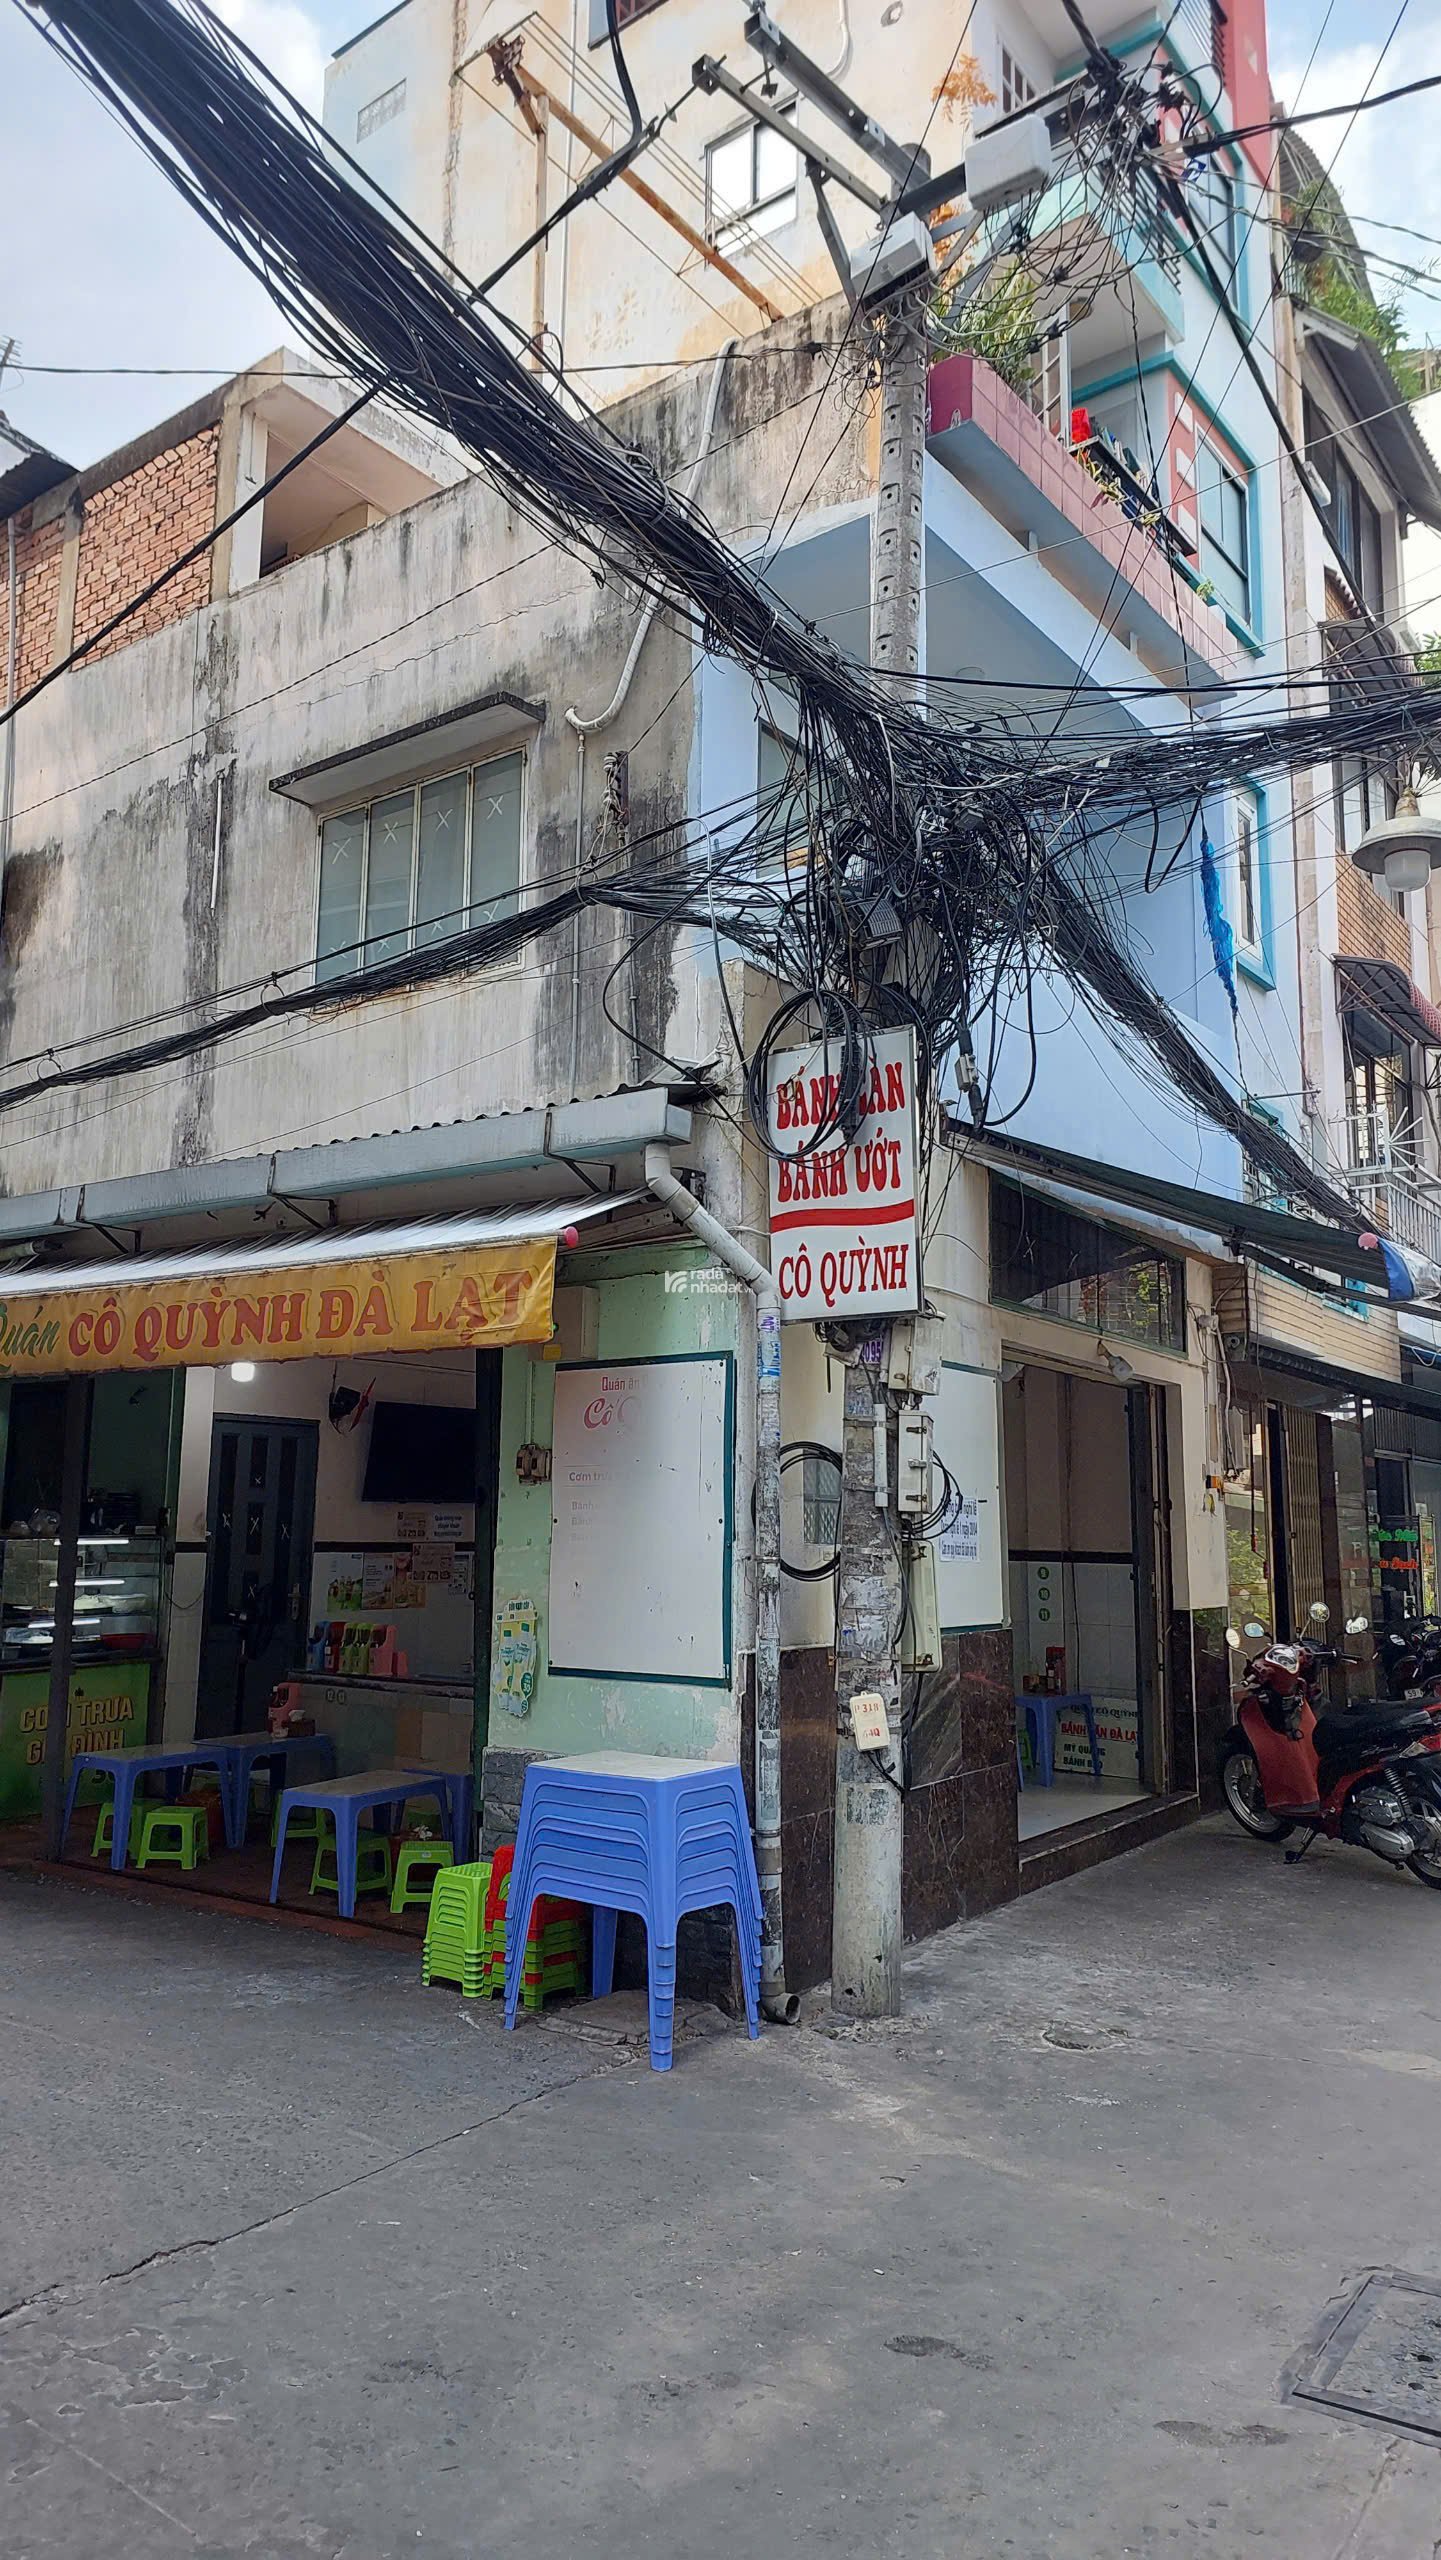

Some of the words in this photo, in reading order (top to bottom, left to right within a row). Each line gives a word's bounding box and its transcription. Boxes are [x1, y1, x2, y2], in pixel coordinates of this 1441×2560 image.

[778, 1140, 848, 1202] BÁNH
[854, 1127, 902, 1193] ƯỚT
[778, 1243, 812, 1300] CÔ
[820, 1235, 909, 1308] QUỲNH
[68, 1297, 121, 1357] CÔ
[132, 1286, 306, 1362] QUỲNH
[315, 1270, 394, 1339] ĐÀ
[410, 1270, 533, 1344] LẠT
[602, 1376, 626, 1392] Quán
[569, 1471, 592, 1482] Cơm
